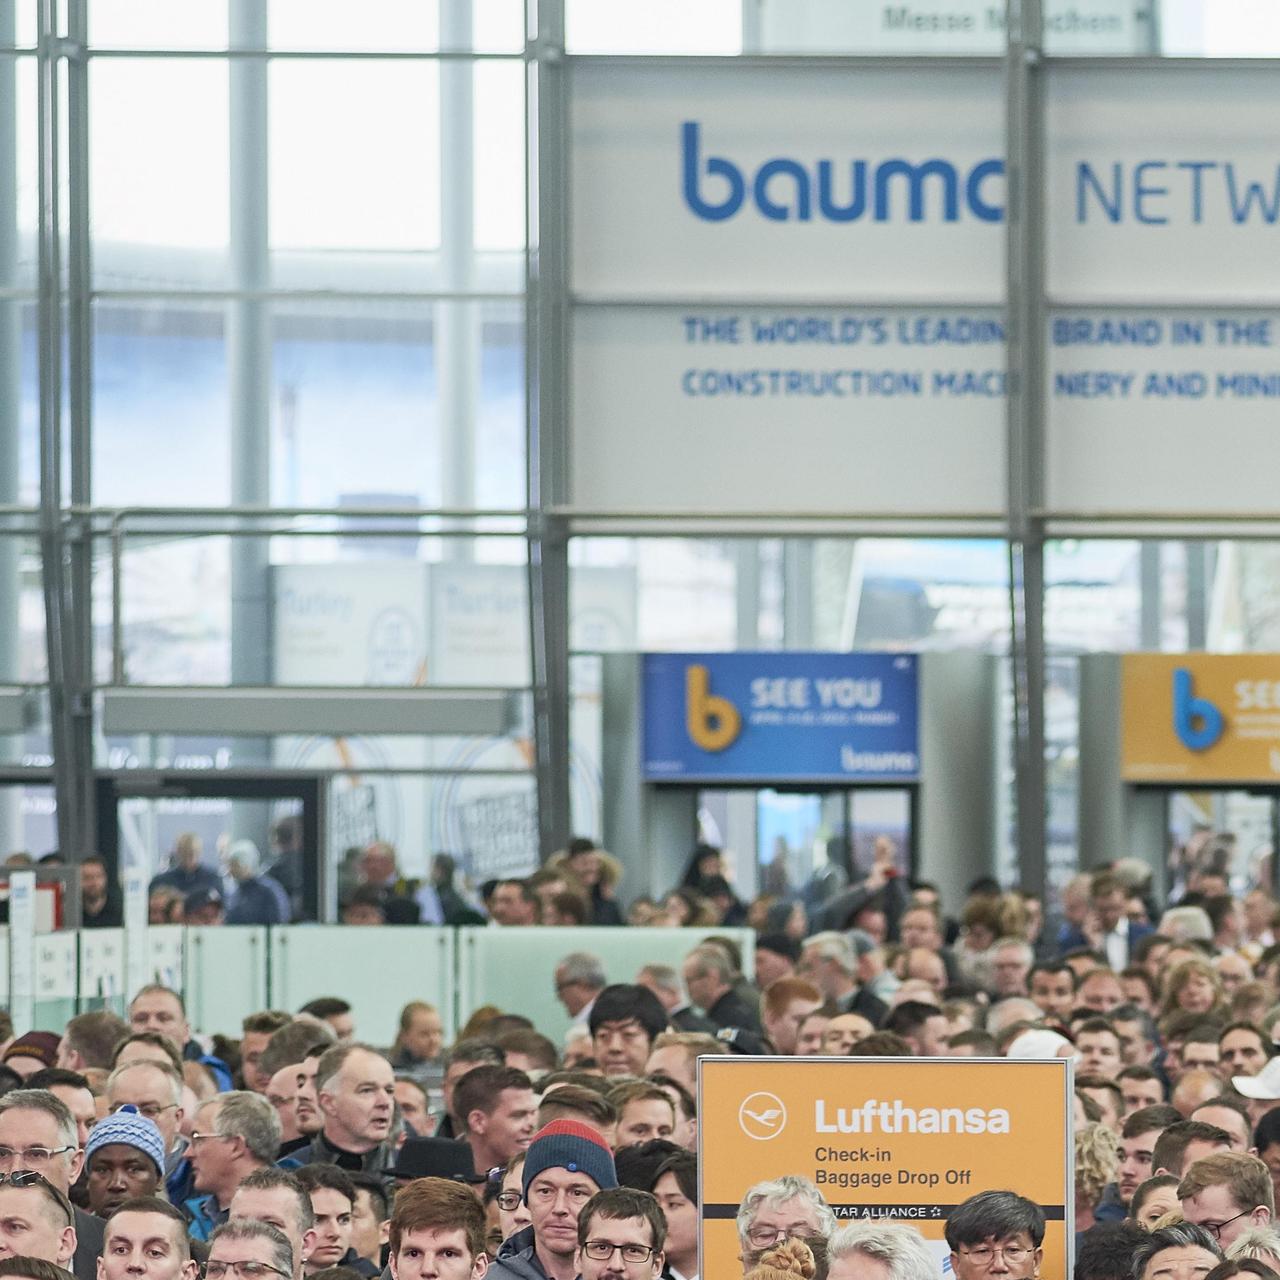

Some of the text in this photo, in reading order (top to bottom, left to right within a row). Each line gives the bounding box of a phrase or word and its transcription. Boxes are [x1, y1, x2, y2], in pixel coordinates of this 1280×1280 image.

[682, 318, 1273, 347] THE WORLD'S LEADIN BRAND IN THE
[682, 370, 920, 398] CONSTRUCTION
[1143, 373, 1206, 400] AND
[751, 677, 882, 708] SEE YOU
[815, 1099, 1010, 1134] Lufthansa
[815, 1147, 892, 1162] Check-in
[815, 1170, 972, 1188] Baggage Drop Off
[832, 1206, 926, 1217] TAR ALLIANCE
